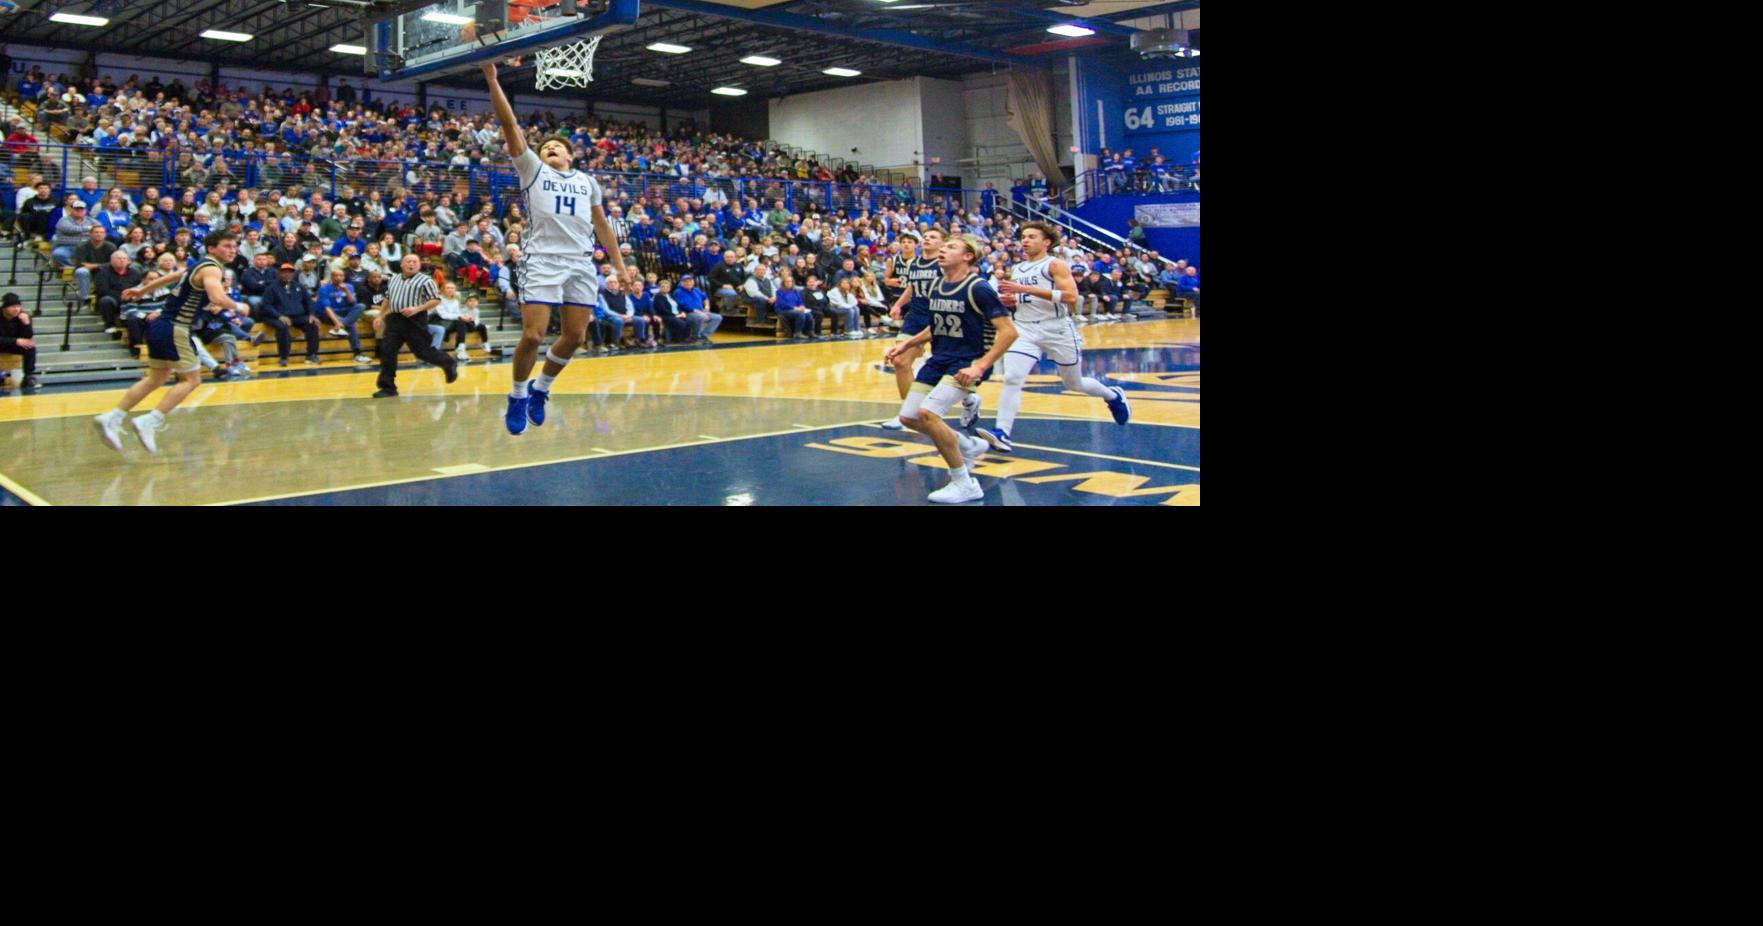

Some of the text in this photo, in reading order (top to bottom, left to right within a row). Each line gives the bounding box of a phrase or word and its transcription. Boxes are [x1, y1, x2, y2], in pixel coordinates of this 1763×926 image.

[1129, 70, 1172, 85] ILLINOIS
[1136, 85, 1153, 96] AA
[1157, 102, 1197, 116] STRAIGHT
[1124, 105, 1155, 130] 64
[1166, 114, 1200, 127] 1981-19
[543, 179, 588, 196] DEVILS
[555, 195, 576, 216] 14
[909, 269, 937, 280] RAIDERS
[929, 298, 965, 313] RAIDERS
[933, 312, 964, 338] 22
